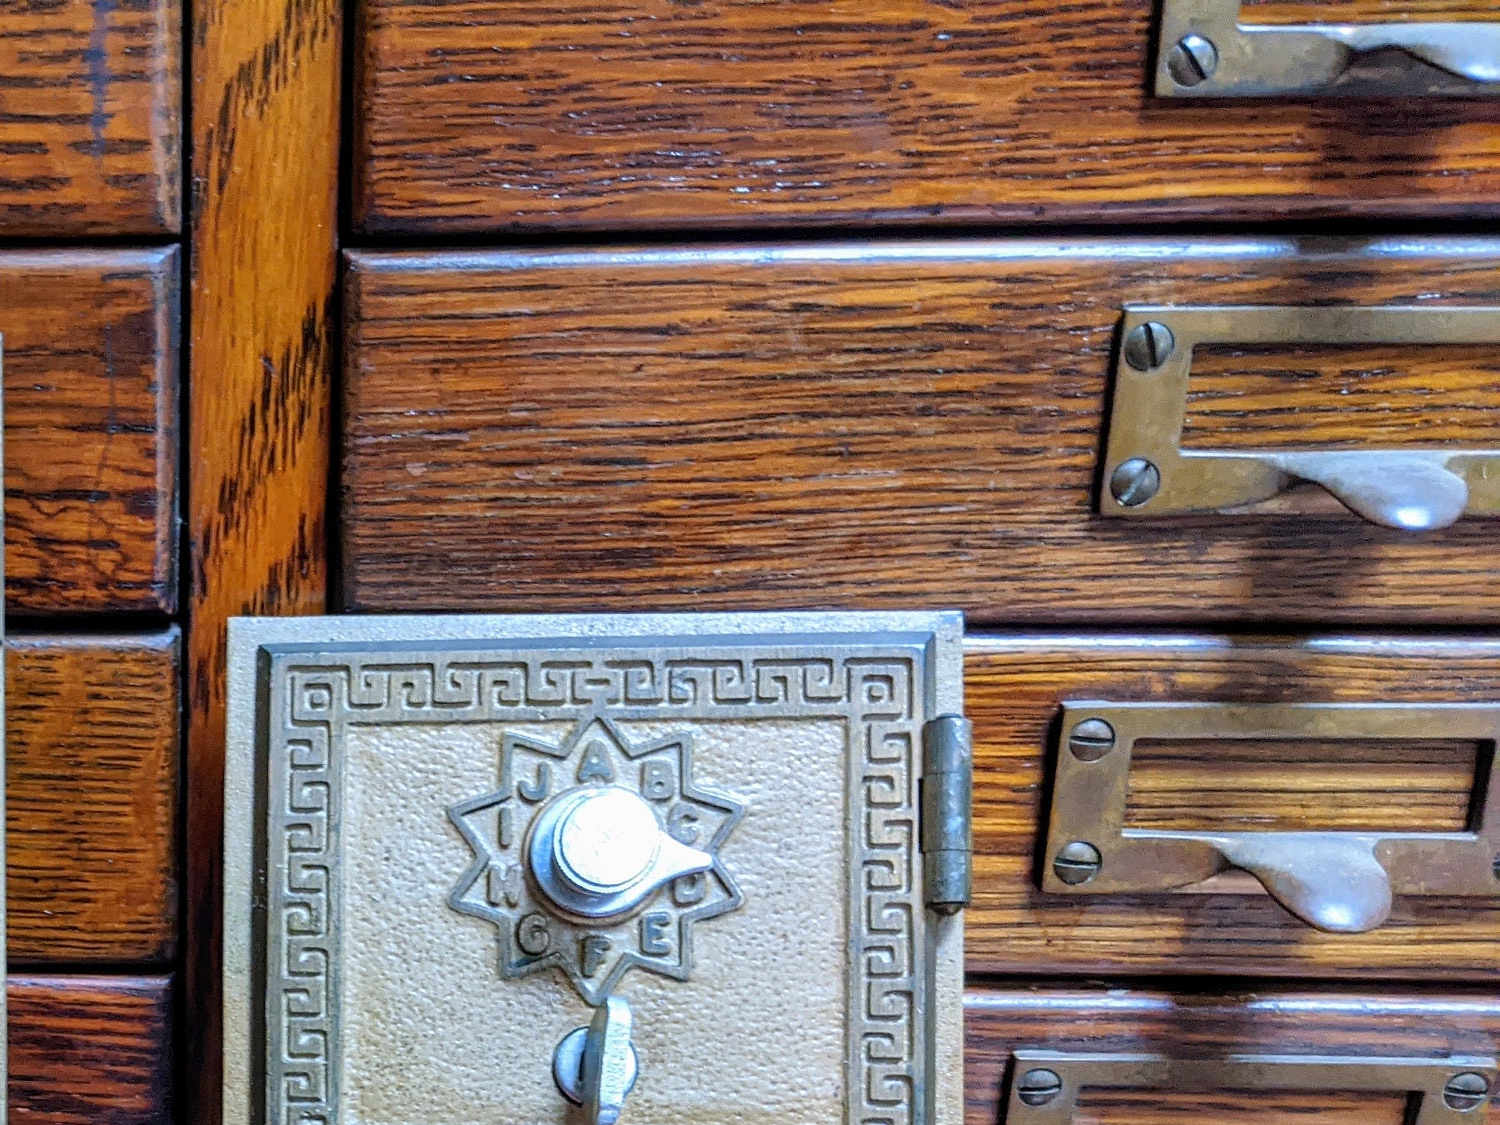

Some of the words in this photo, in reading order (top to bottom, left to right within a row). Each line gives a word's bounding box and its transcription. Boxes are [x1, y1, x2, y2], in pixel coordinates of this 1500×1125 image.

[517, 762, 551, 802] J
[578, 740, 614, 782] A
[640, 760, 674, 802] B
[498, 807, 511, 849] I
[667, 802, 700, 844] C
[486, 863, 523, 907] H
[516, 913, 551, 956] G
[640, 912, 671, 956] E
[581, 935, 611, 978] F
